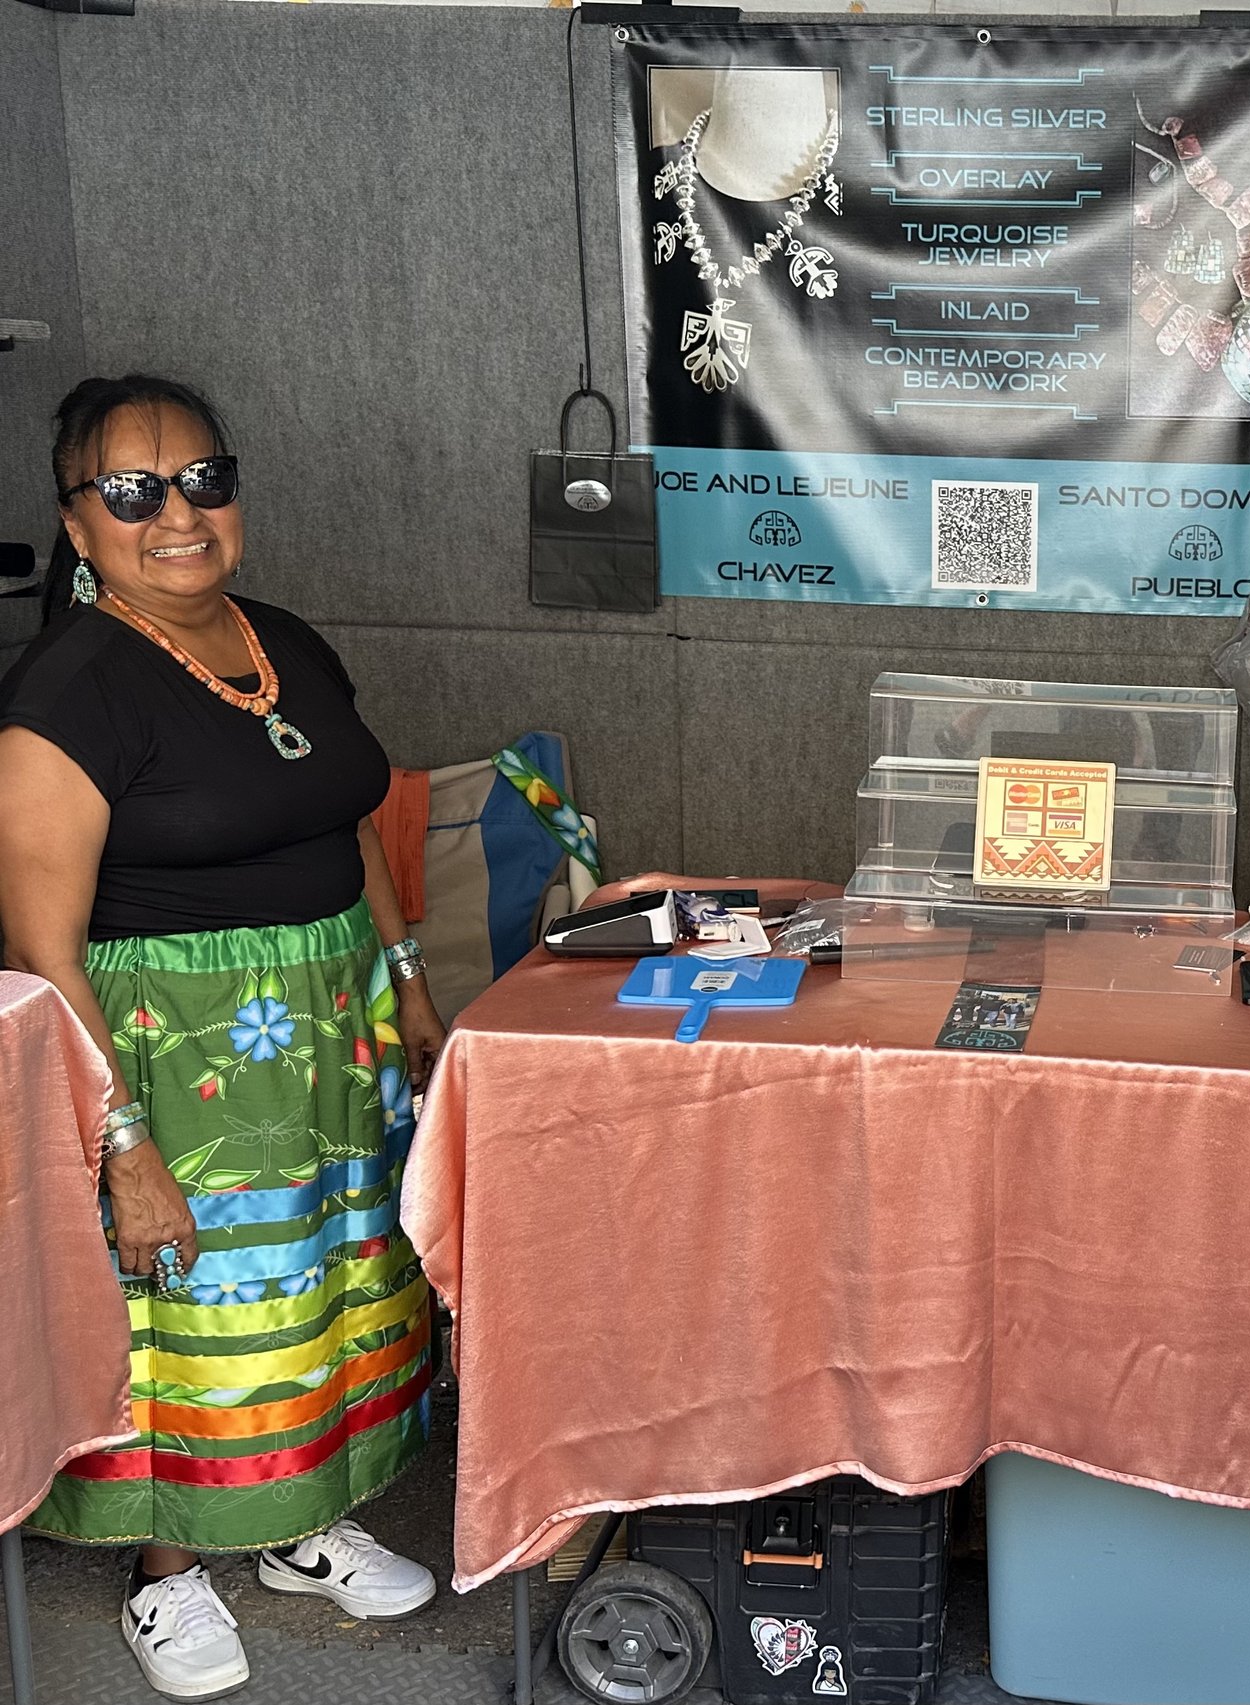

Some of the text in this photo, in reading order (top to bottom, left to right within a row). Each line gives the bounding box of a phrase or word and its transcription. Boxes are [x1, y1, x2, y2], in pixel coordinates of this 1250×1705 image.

[866, 106, 1107, 129] STERLING SILVER
[919, 168, 1054, 189] OVERLAY
[901, 223, 1069, 245] TURQUOISE
[918, 246, 1051, 268] JEWELRY
[940, 300, 1031, 321] INLAID
[865, 346, 1107, 370] CONTEMPORARY
[903, 370, 1068, 393] BEADWORK
[653, 470, 909, 500] JOE AND LEJEUNE
[1058, 485, 1170, 509] SANTO
[717, 561, 836, 585] CHAVEZ
[988, 766, 1107, 780] Debit & Credit Cards Accepted
[1054, 820, 1077, 830] VISA
